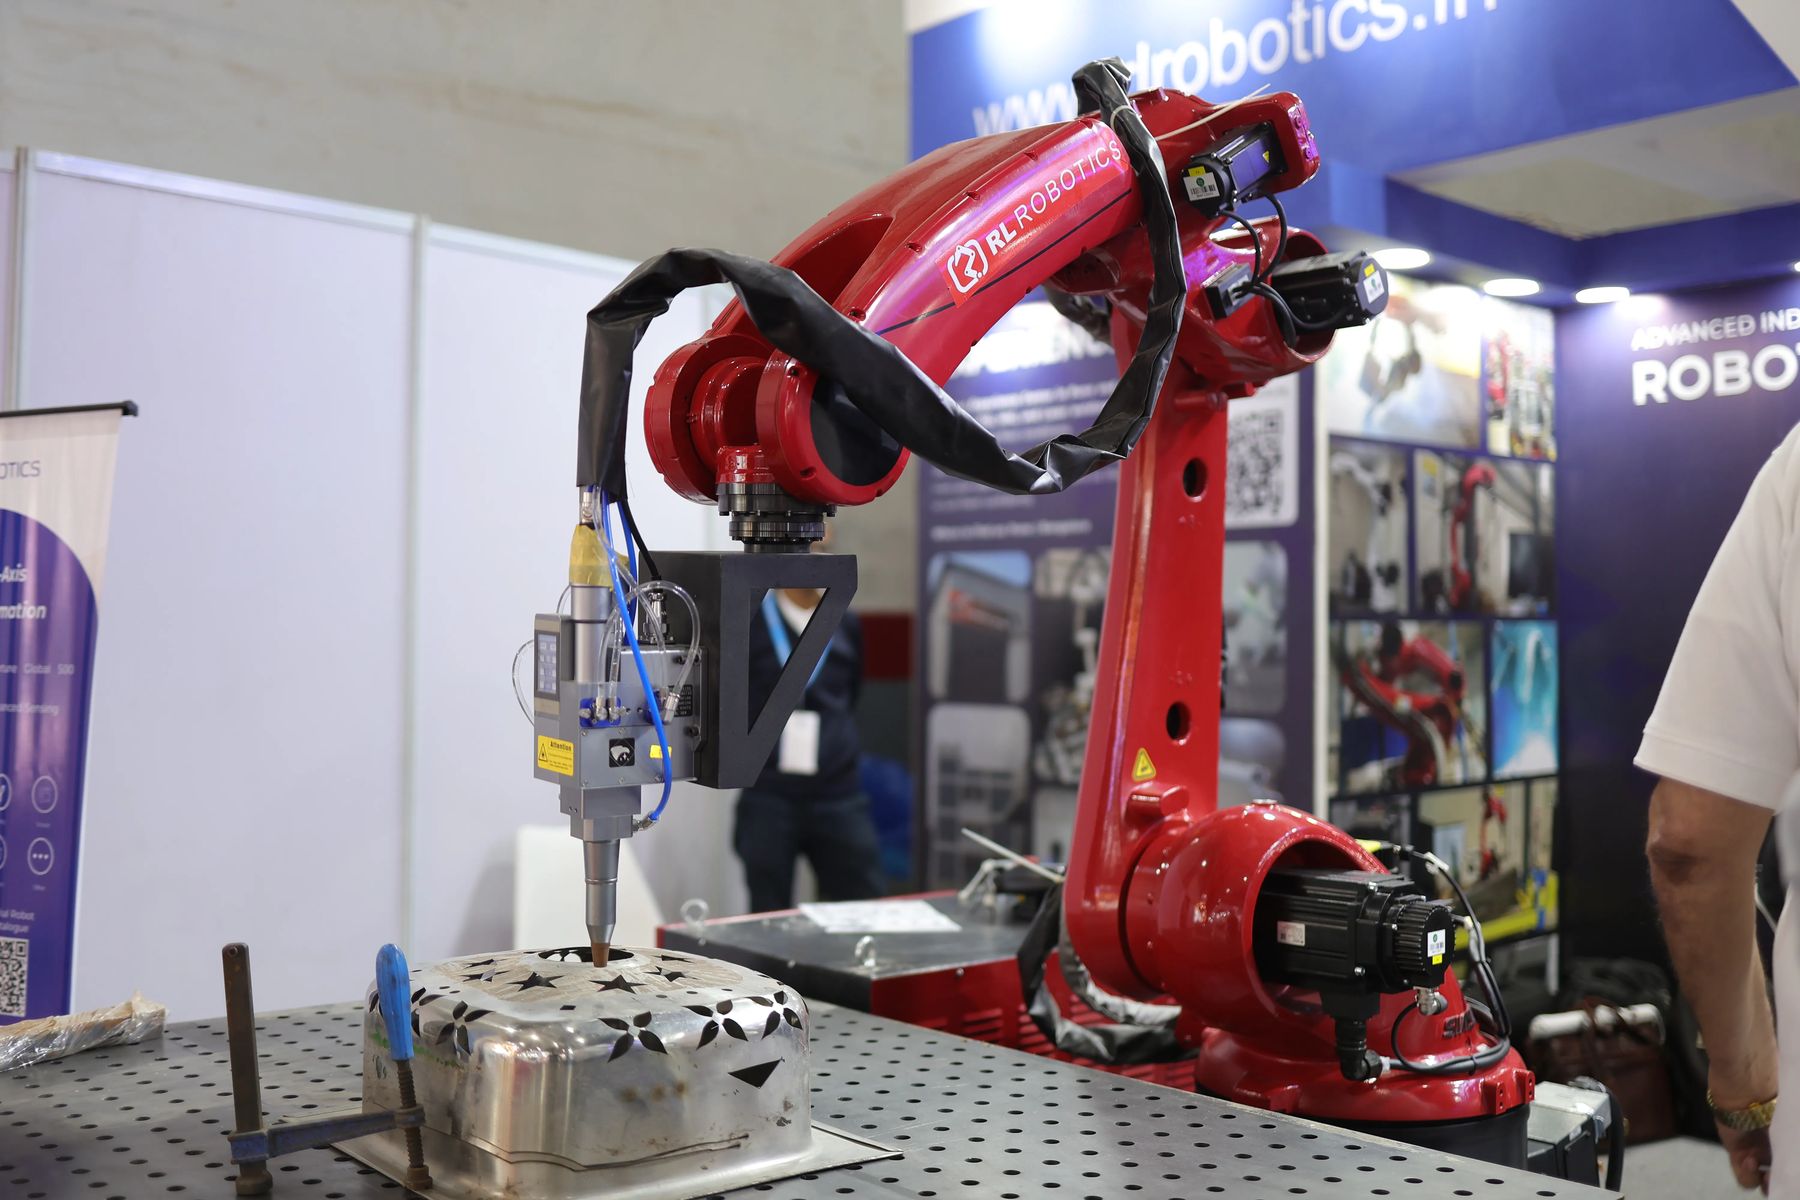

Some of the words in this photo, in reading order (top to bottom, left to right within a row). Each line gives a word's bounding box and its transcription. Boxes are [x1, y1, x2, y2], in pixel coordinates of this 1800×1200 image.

[985, 220, 1017, 256] RL
[1014, 139, 1121, 230] ROBOTICS
[1631, 314, 1756, 351] ADVANCED
[1632, 343, 1800, 406] ROBO
